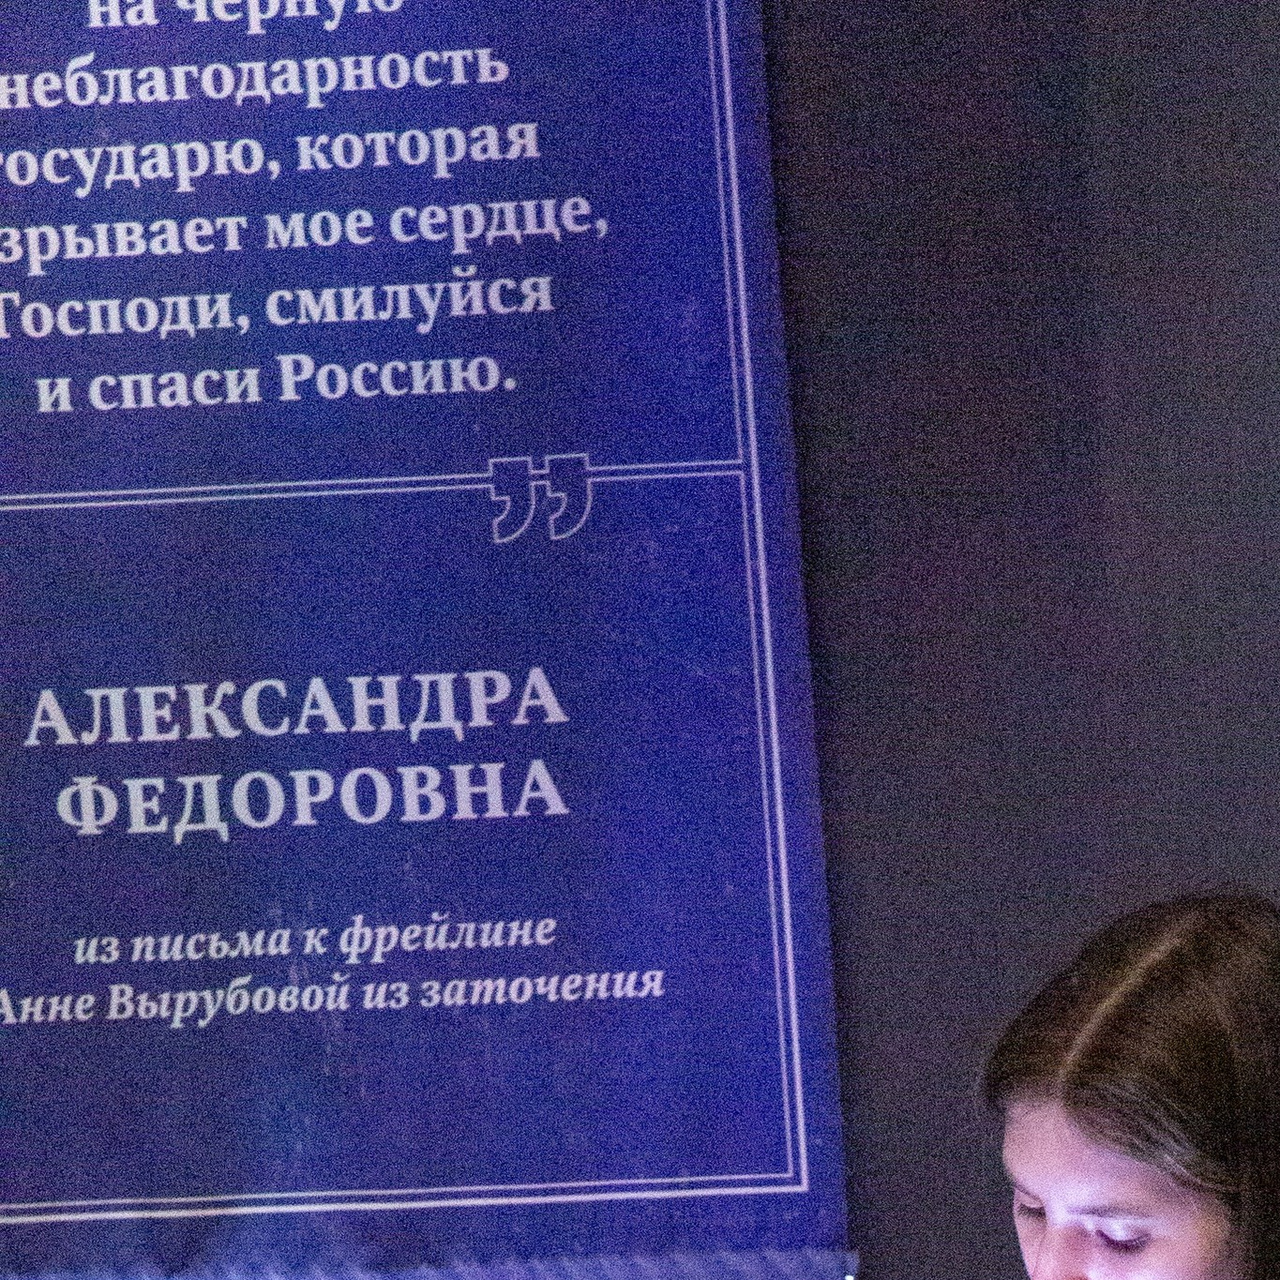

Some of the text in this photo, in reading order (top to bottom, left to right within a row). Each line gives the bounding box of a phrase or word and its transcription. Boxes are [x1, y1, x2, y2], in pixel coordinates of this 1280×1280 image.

[89, 0, 157, 27] на
[0, 49, 508, 110] неблагодарность
[0, 124, 539, 198] осударю, которая
[0, 197, 607, 276] зрывает мое сердце,
[0, 265, 552, 338] Господи, смилуйся
[37, 354, 515, 412] и спаси Россию.
[25, 668, 567, 746] АЛЕКСАНДРА
[57, 760, 568, 844] ФЕДОРОВНА
[75, 912, 556, 965] из письма к фрейлине
[108, 972, 350, 1029] Вырубовой
[363, 982, 409, 1009] из
[421, 970, 664, 1007] заточения
